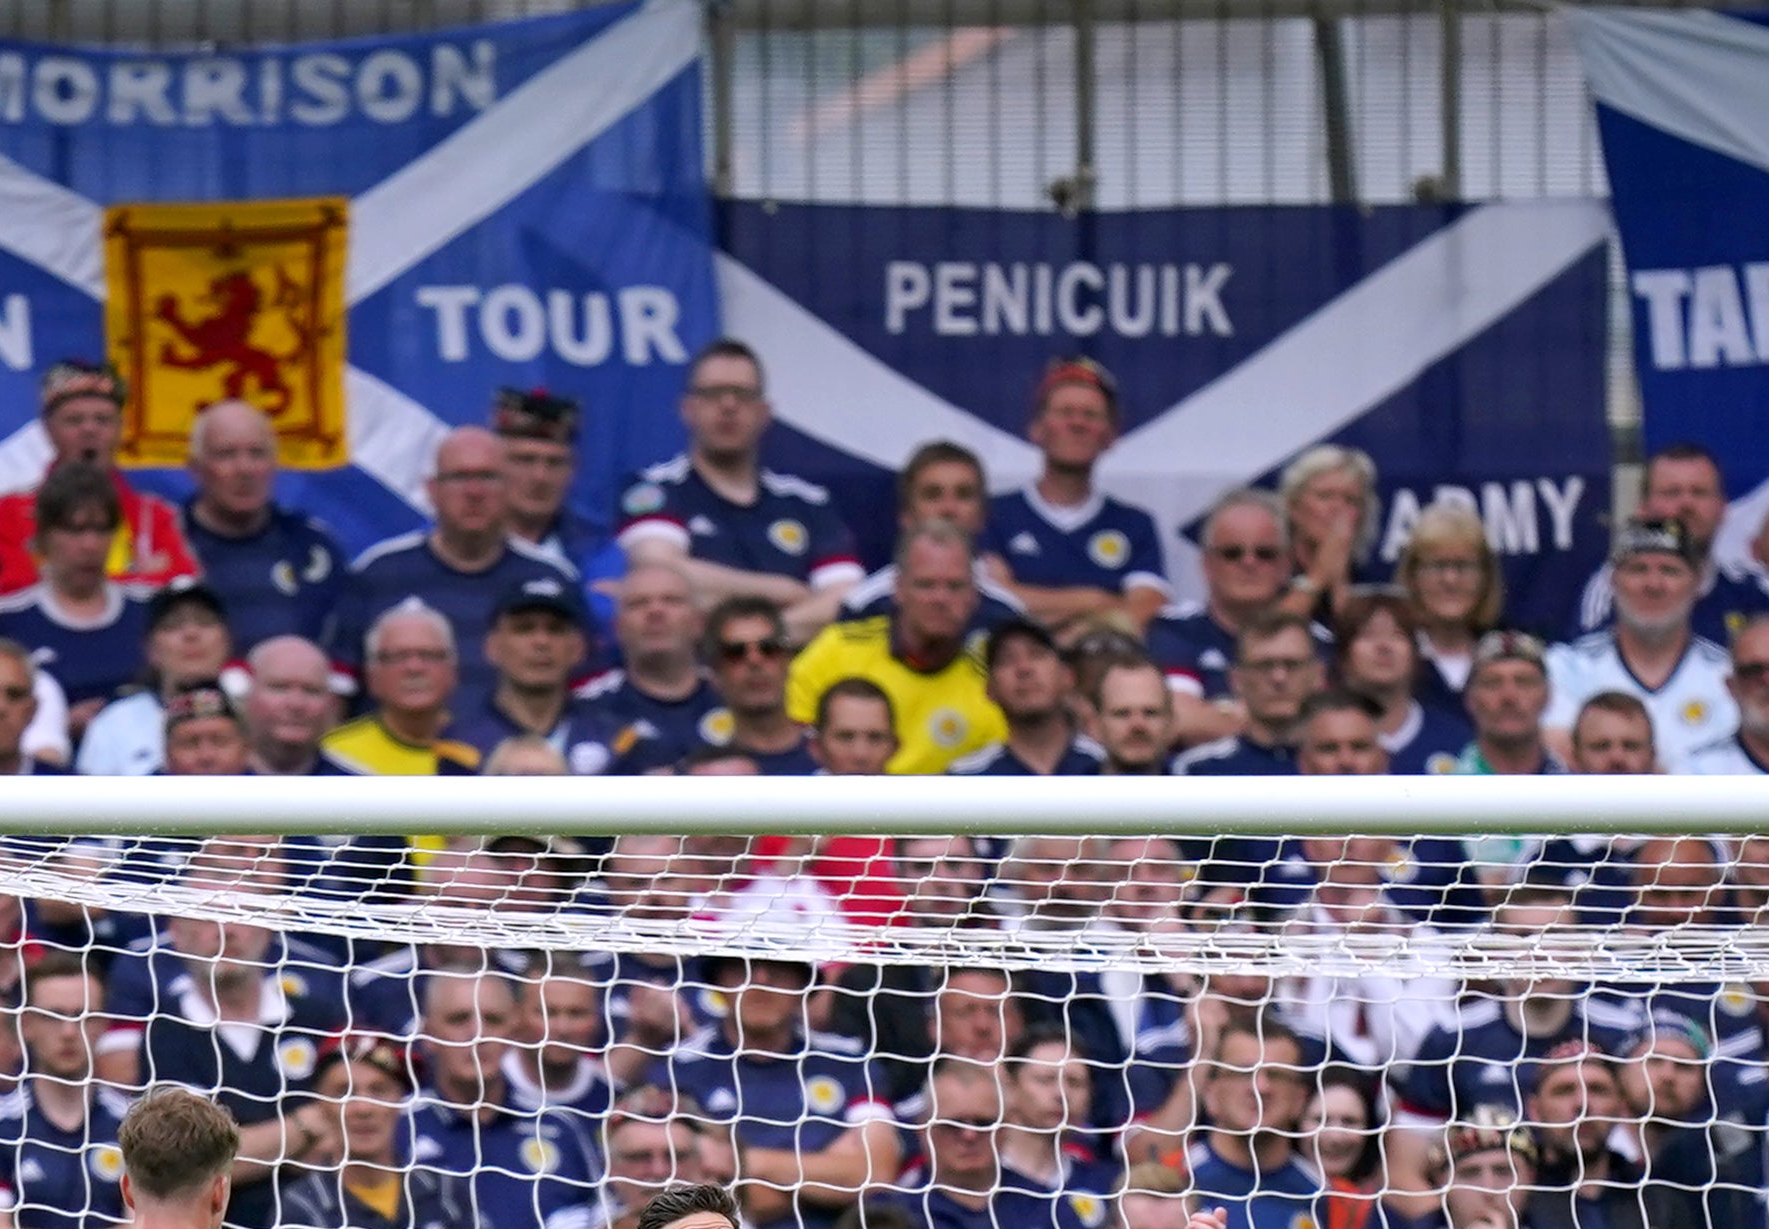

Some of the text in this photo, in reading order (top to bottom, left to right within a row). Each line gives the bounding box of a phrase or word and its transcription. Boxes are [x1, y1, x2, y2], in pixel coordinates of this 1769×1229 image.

[415, 284, 692, 367] TOUR
[884, 259, 1233, 338] PENICUIK
[1632, 260, 1769, 370] TA
